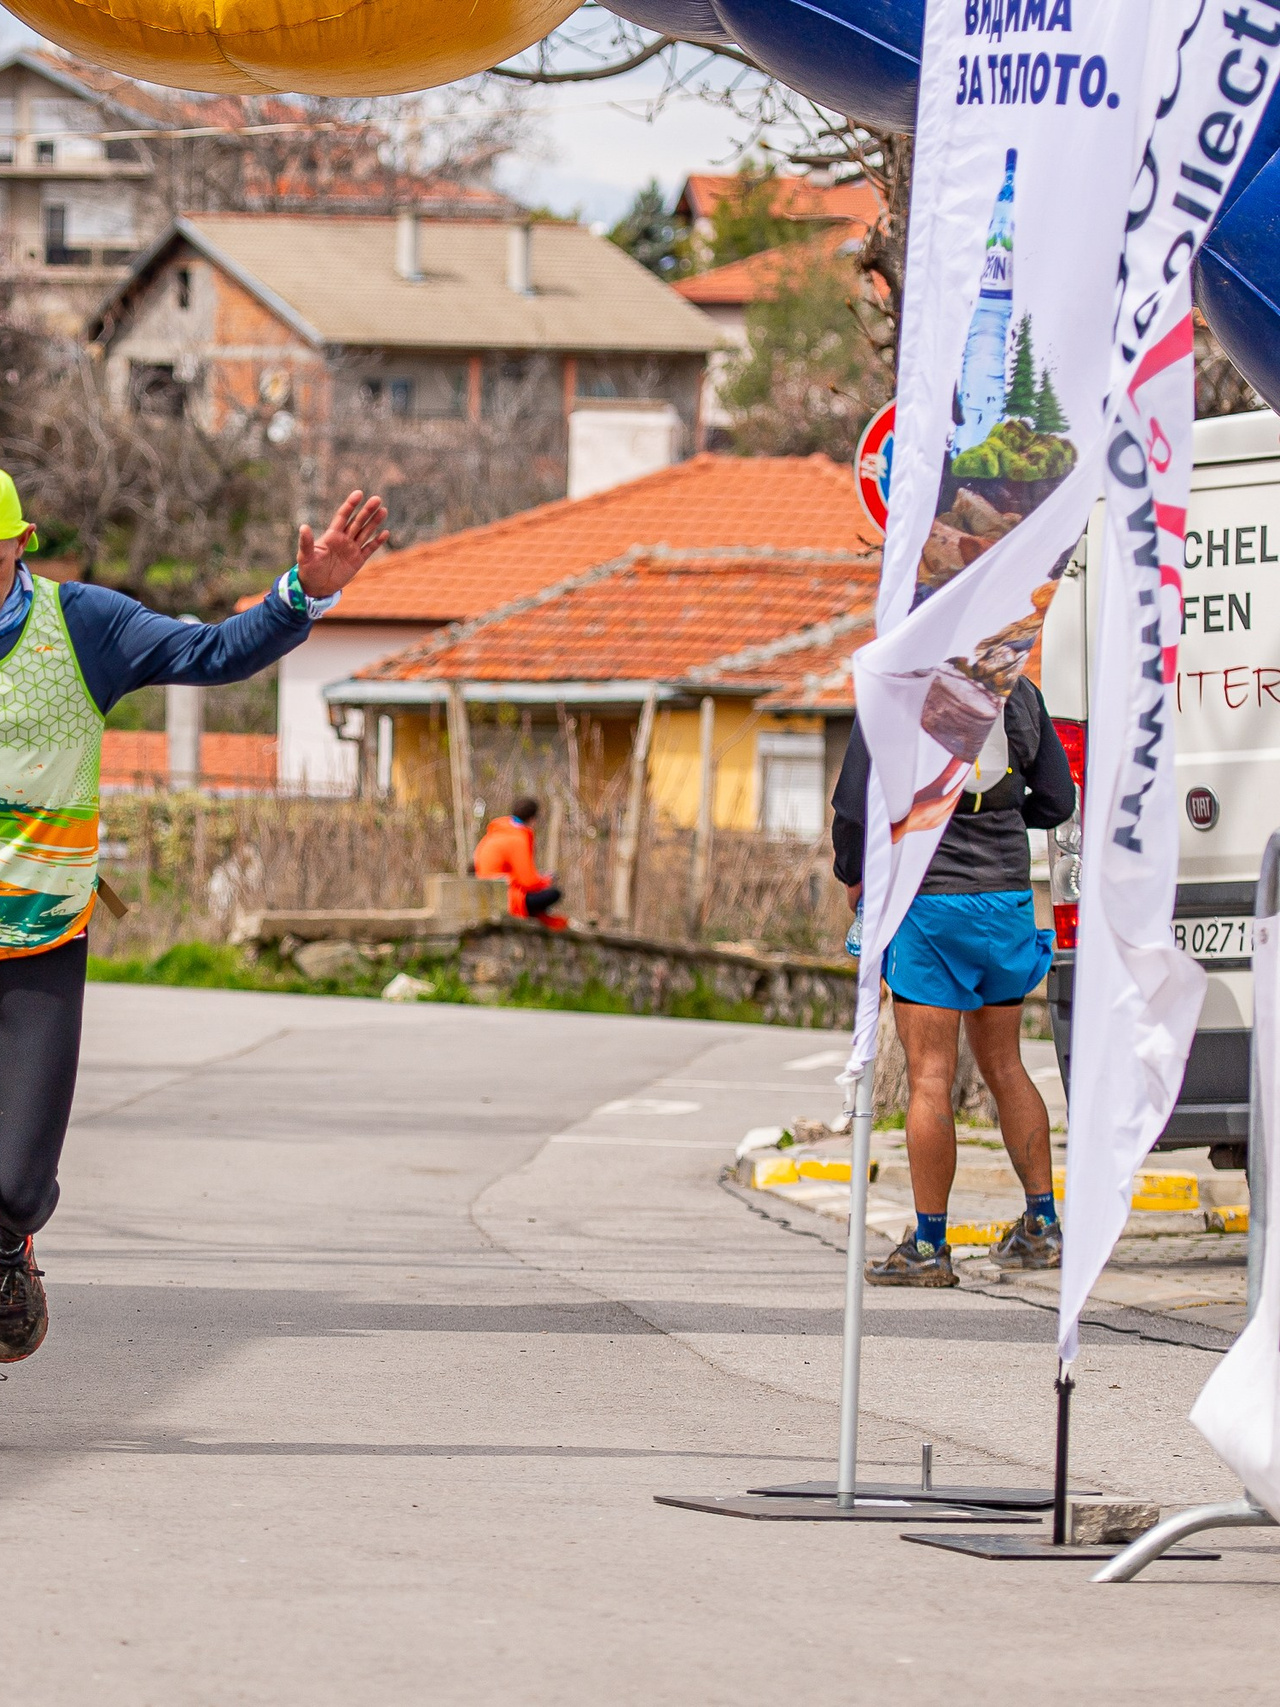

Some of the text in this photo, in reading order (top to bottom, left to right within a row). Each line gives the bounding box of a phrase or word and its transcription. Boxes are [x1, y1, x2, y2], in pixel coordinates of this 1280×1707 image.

[965, 0, 1073, 43] ВИДИМА
[956, 52, 1120, 109] ЗА ТЯЛОТО.
[1191, 796, 1211, 818] FIAT
